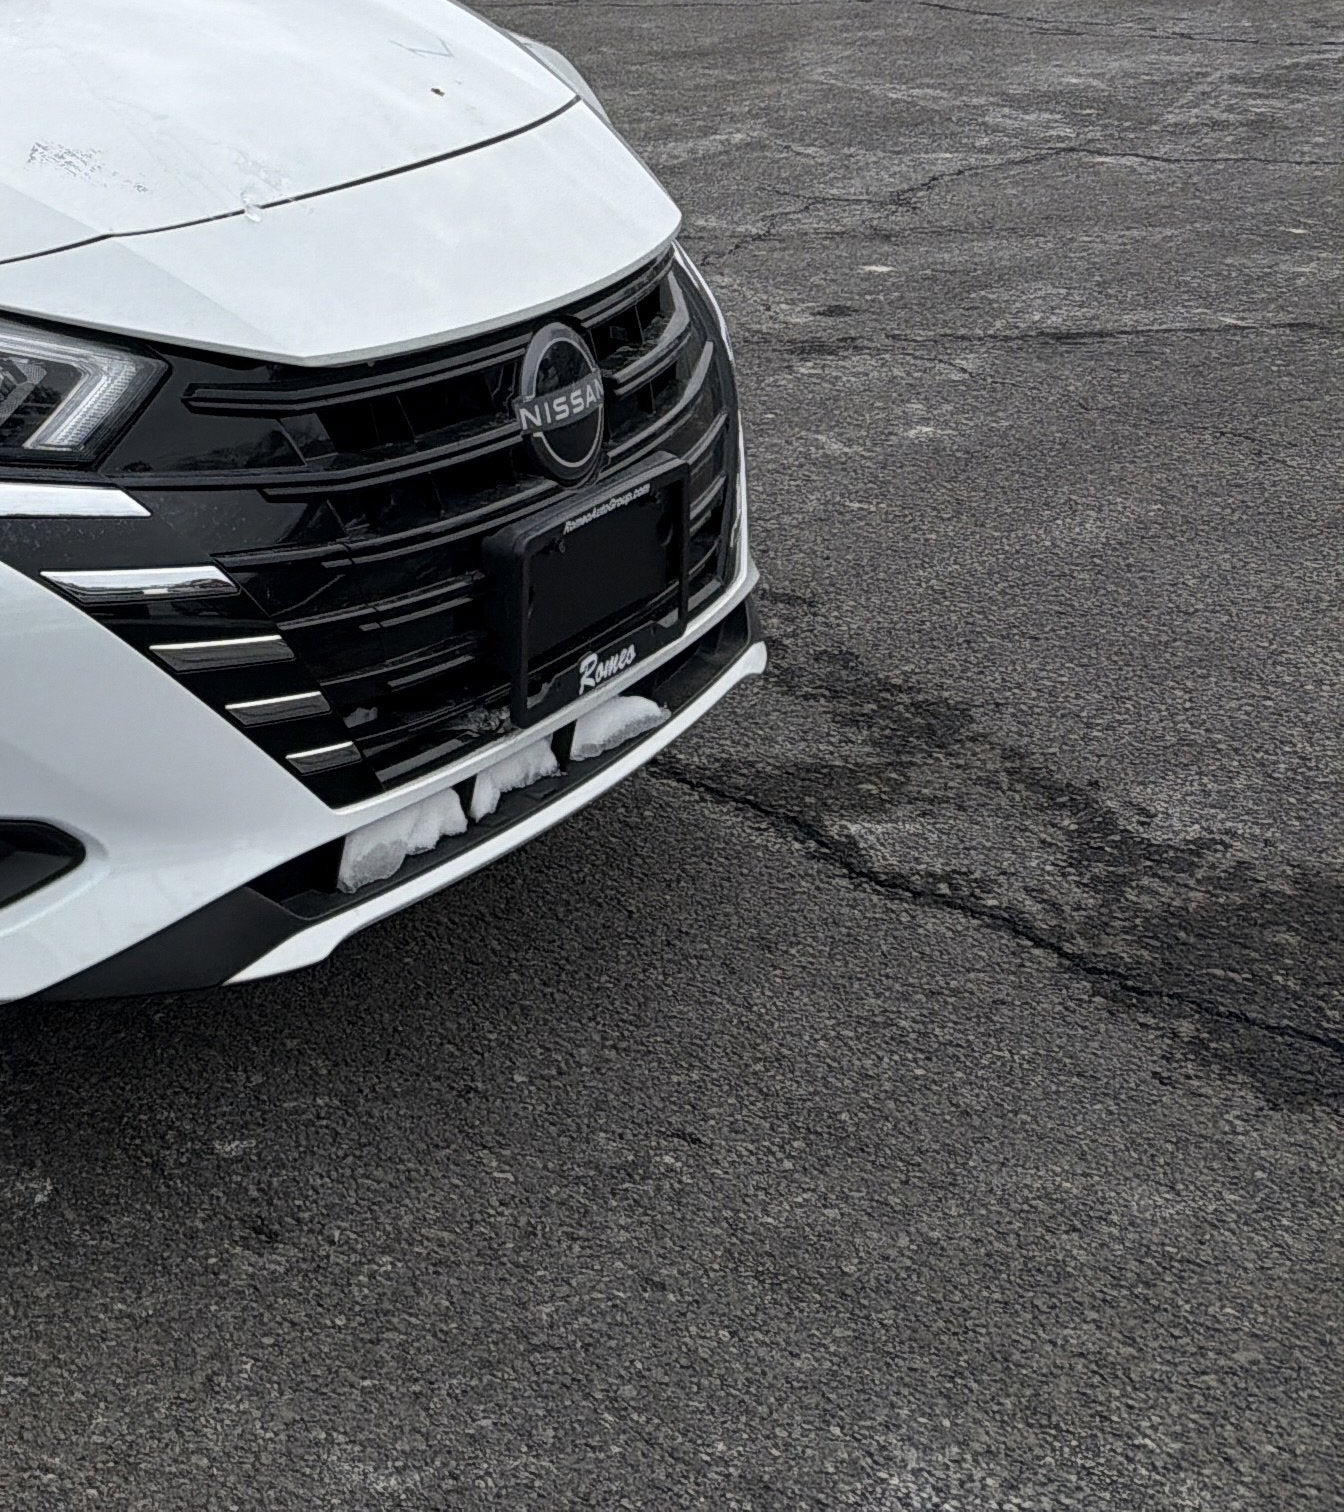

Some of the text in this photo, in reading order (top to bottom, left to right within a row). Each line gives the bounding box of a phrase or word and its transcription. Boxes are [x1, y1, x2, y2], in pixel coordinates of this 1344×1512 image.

[519, 378, 605, 430] NISSAN
[562, 483, 651, 536] RomeoAutoGroup.com
[578, 643, 637, 696] Romeo
